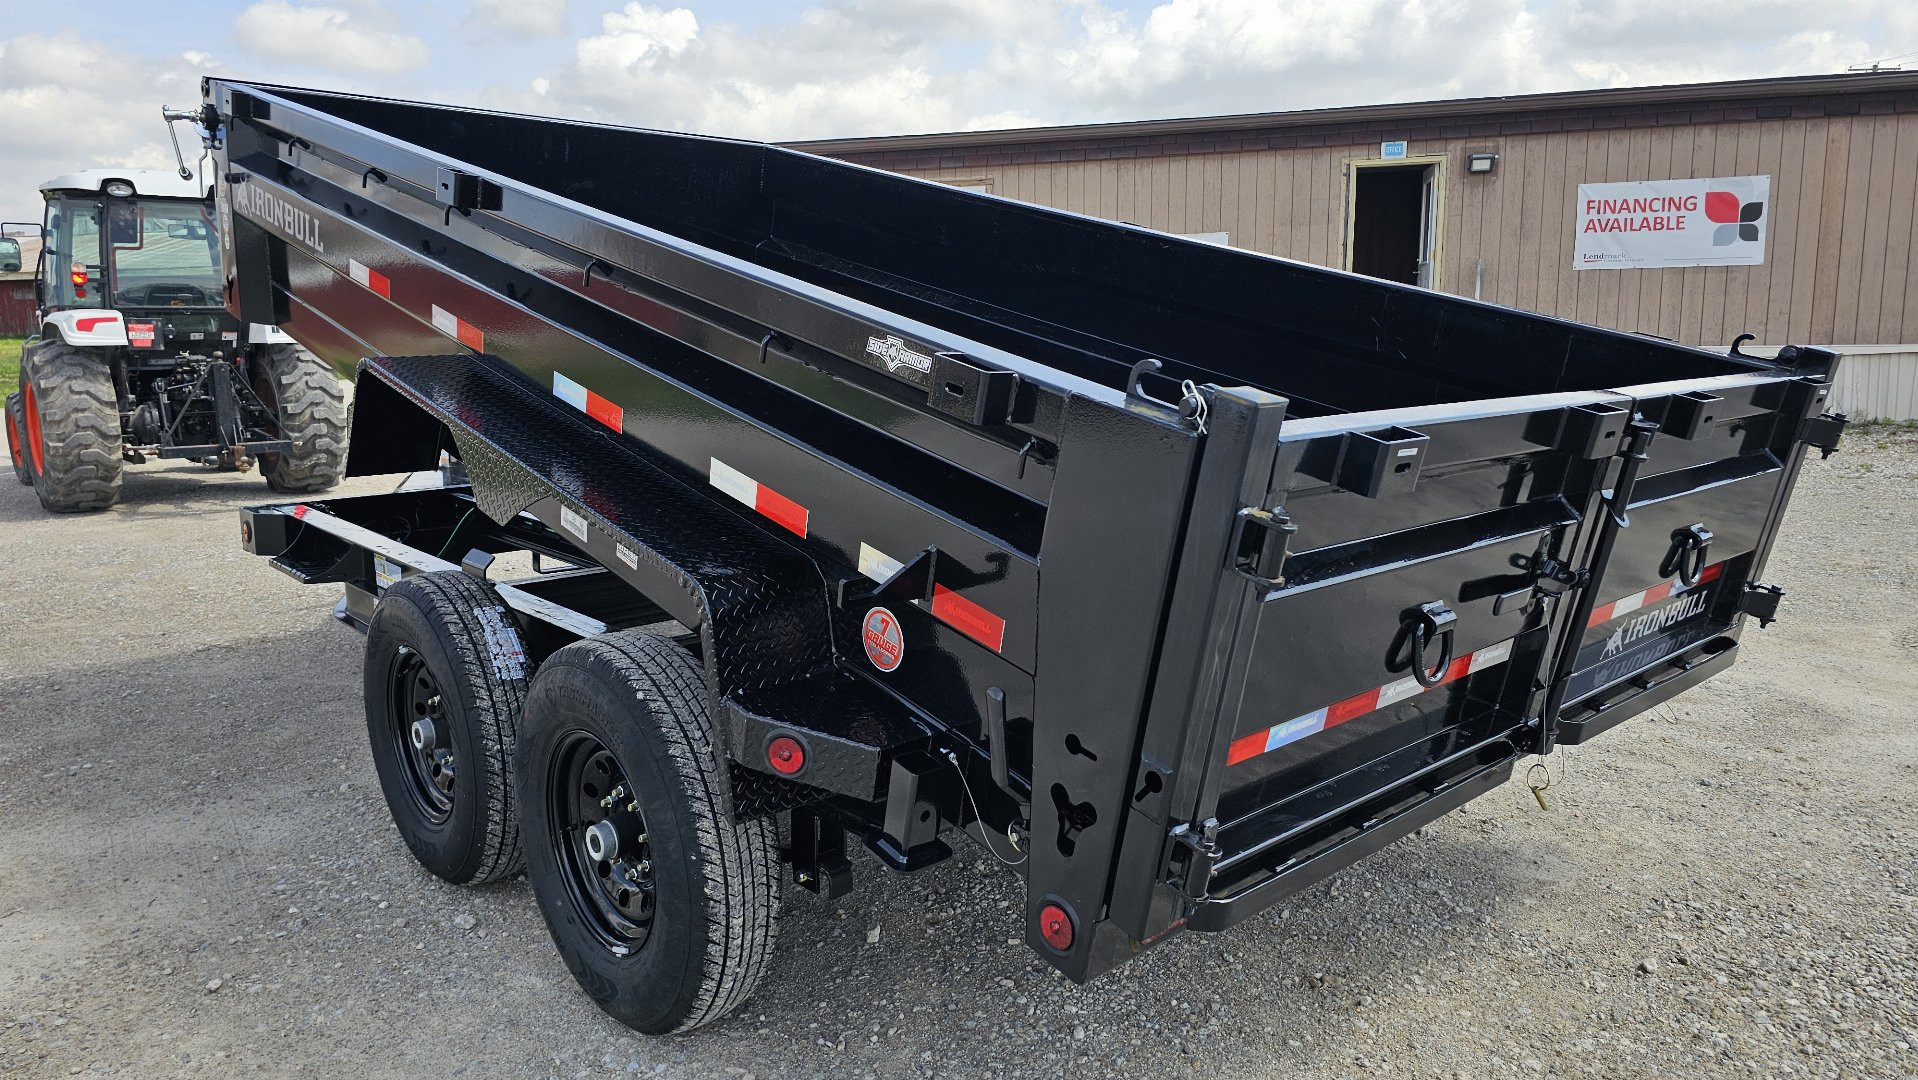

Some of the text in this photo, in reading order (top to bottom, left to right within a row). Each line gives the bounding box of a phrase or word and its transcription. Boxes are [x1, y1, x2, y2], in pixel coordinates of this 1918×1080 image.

[1385, 145, 1402, 153] OFFICE
[1586, 195, 1698, 216] FINANCING
[250, 183, 324, 254] IRONBULL
[1583, 215, 1687, 234] AVAILABLE
[1583, 252, 1627, 260] Lendmark
[880, 616, 891, 638] 7
[1622, 589, 1708, 645] IRONBULL
[868, 630, 899, 657] GAUGE
